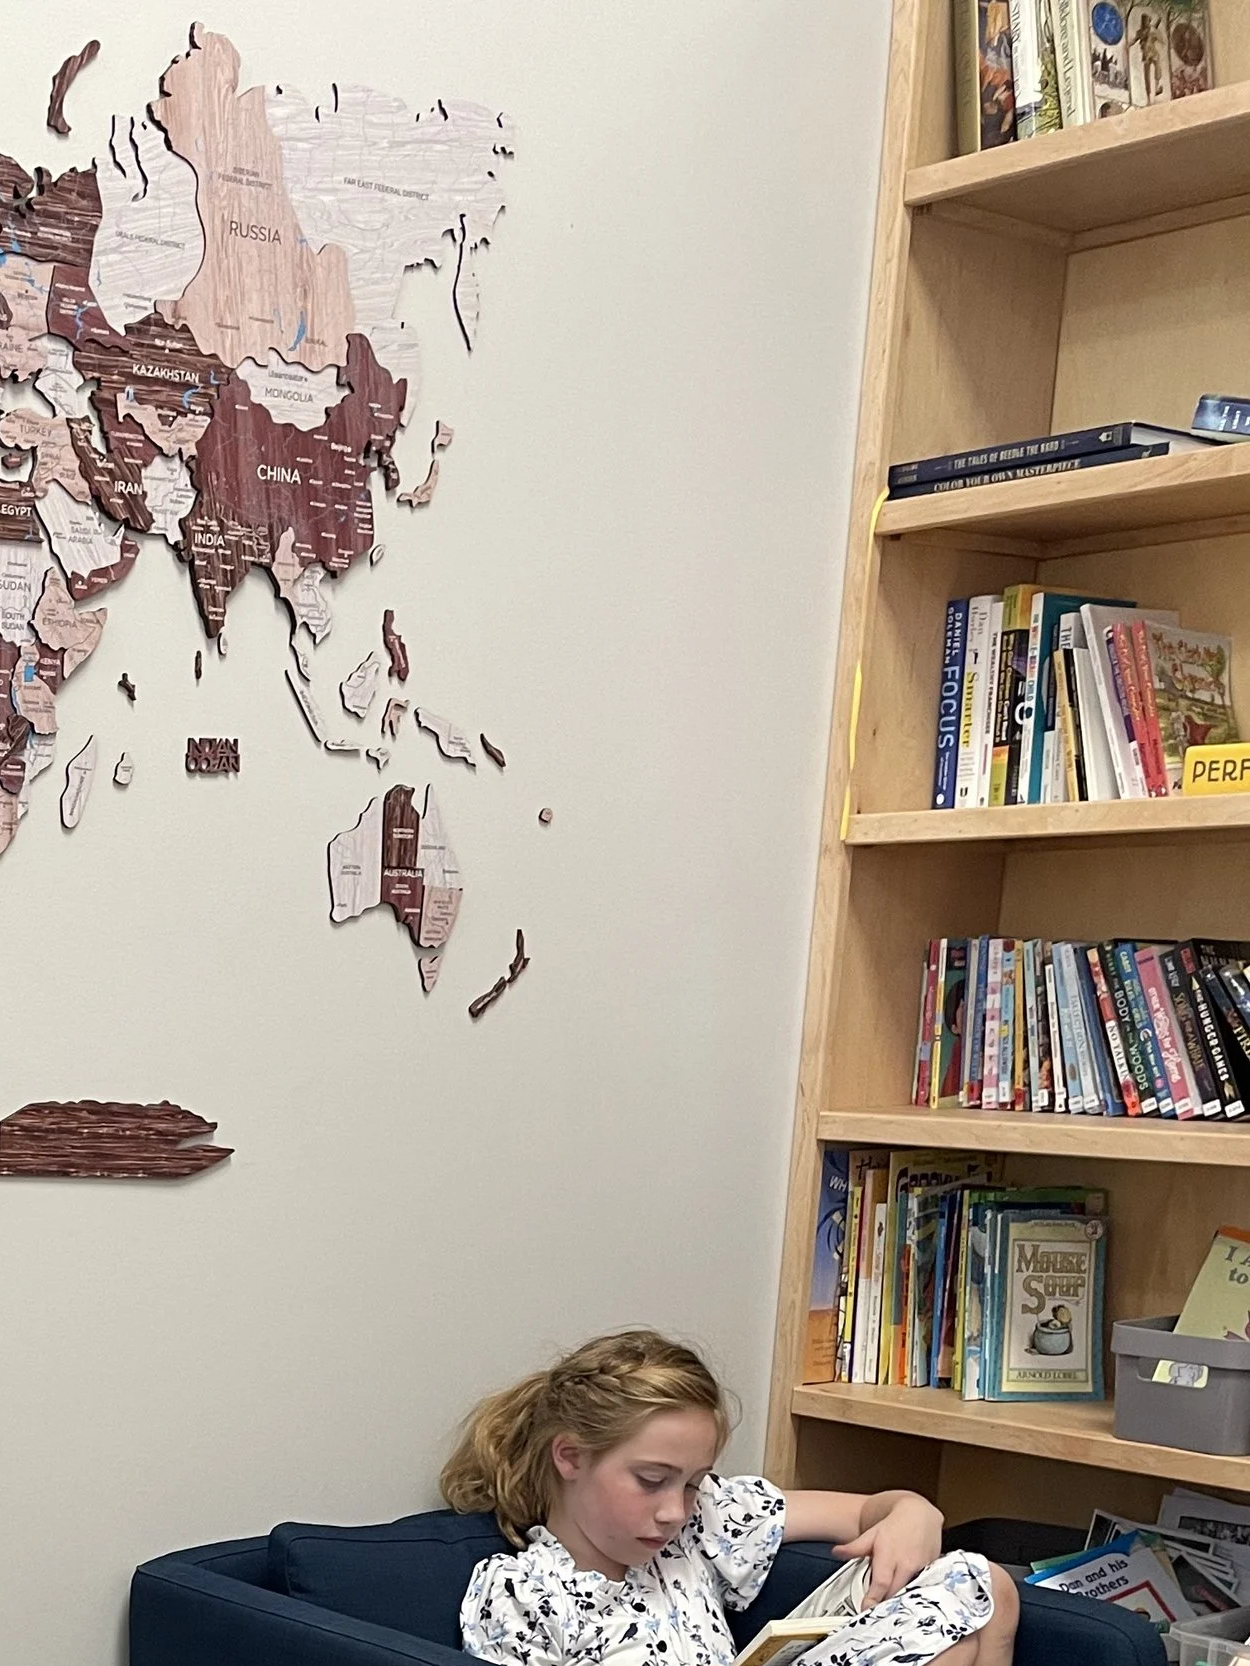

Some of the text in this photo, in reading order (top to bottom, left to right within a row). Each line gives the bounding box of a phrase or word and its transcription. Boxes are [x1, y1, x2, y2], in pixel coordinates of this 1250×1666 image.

[229, 220, 282, 245] RUSSIA
[132, 363, 200, 383] KAZAKHSTAN
[264, 387, 314, 403] MONGOLIA
[256, 463, 302, 485] CHINA
[933, 478, 965, 493] COLOR
[991, 469, 1015, 485] OWN
[1015, 458, 1082, 480] MASTERPIECE
[114, 480, 144, 495] IRAN
[0, 503, 32, 517] EGYPT
[194, 532, 226, 547] INDIA
[951, 612, 963, 656] DANIEL
[937, 665, 960, 750] FOCUS
[961, 671, 979, 748] Smarter
[1191, 759, 1250, 783] PERF
[383, 868, 424, 879] AUSTRALIA
[1113, 989, 1132, 1023] BODY
[1129, 1045, 1150, 1091] WOODS
[1112, 1044, 1130, 1083] TALKIN
[1228, 1267, 1249, 1285] to
[1058, 1559, 1128, 1593] Dan and his
[1076, 1575, 1129, 1599] rothers
